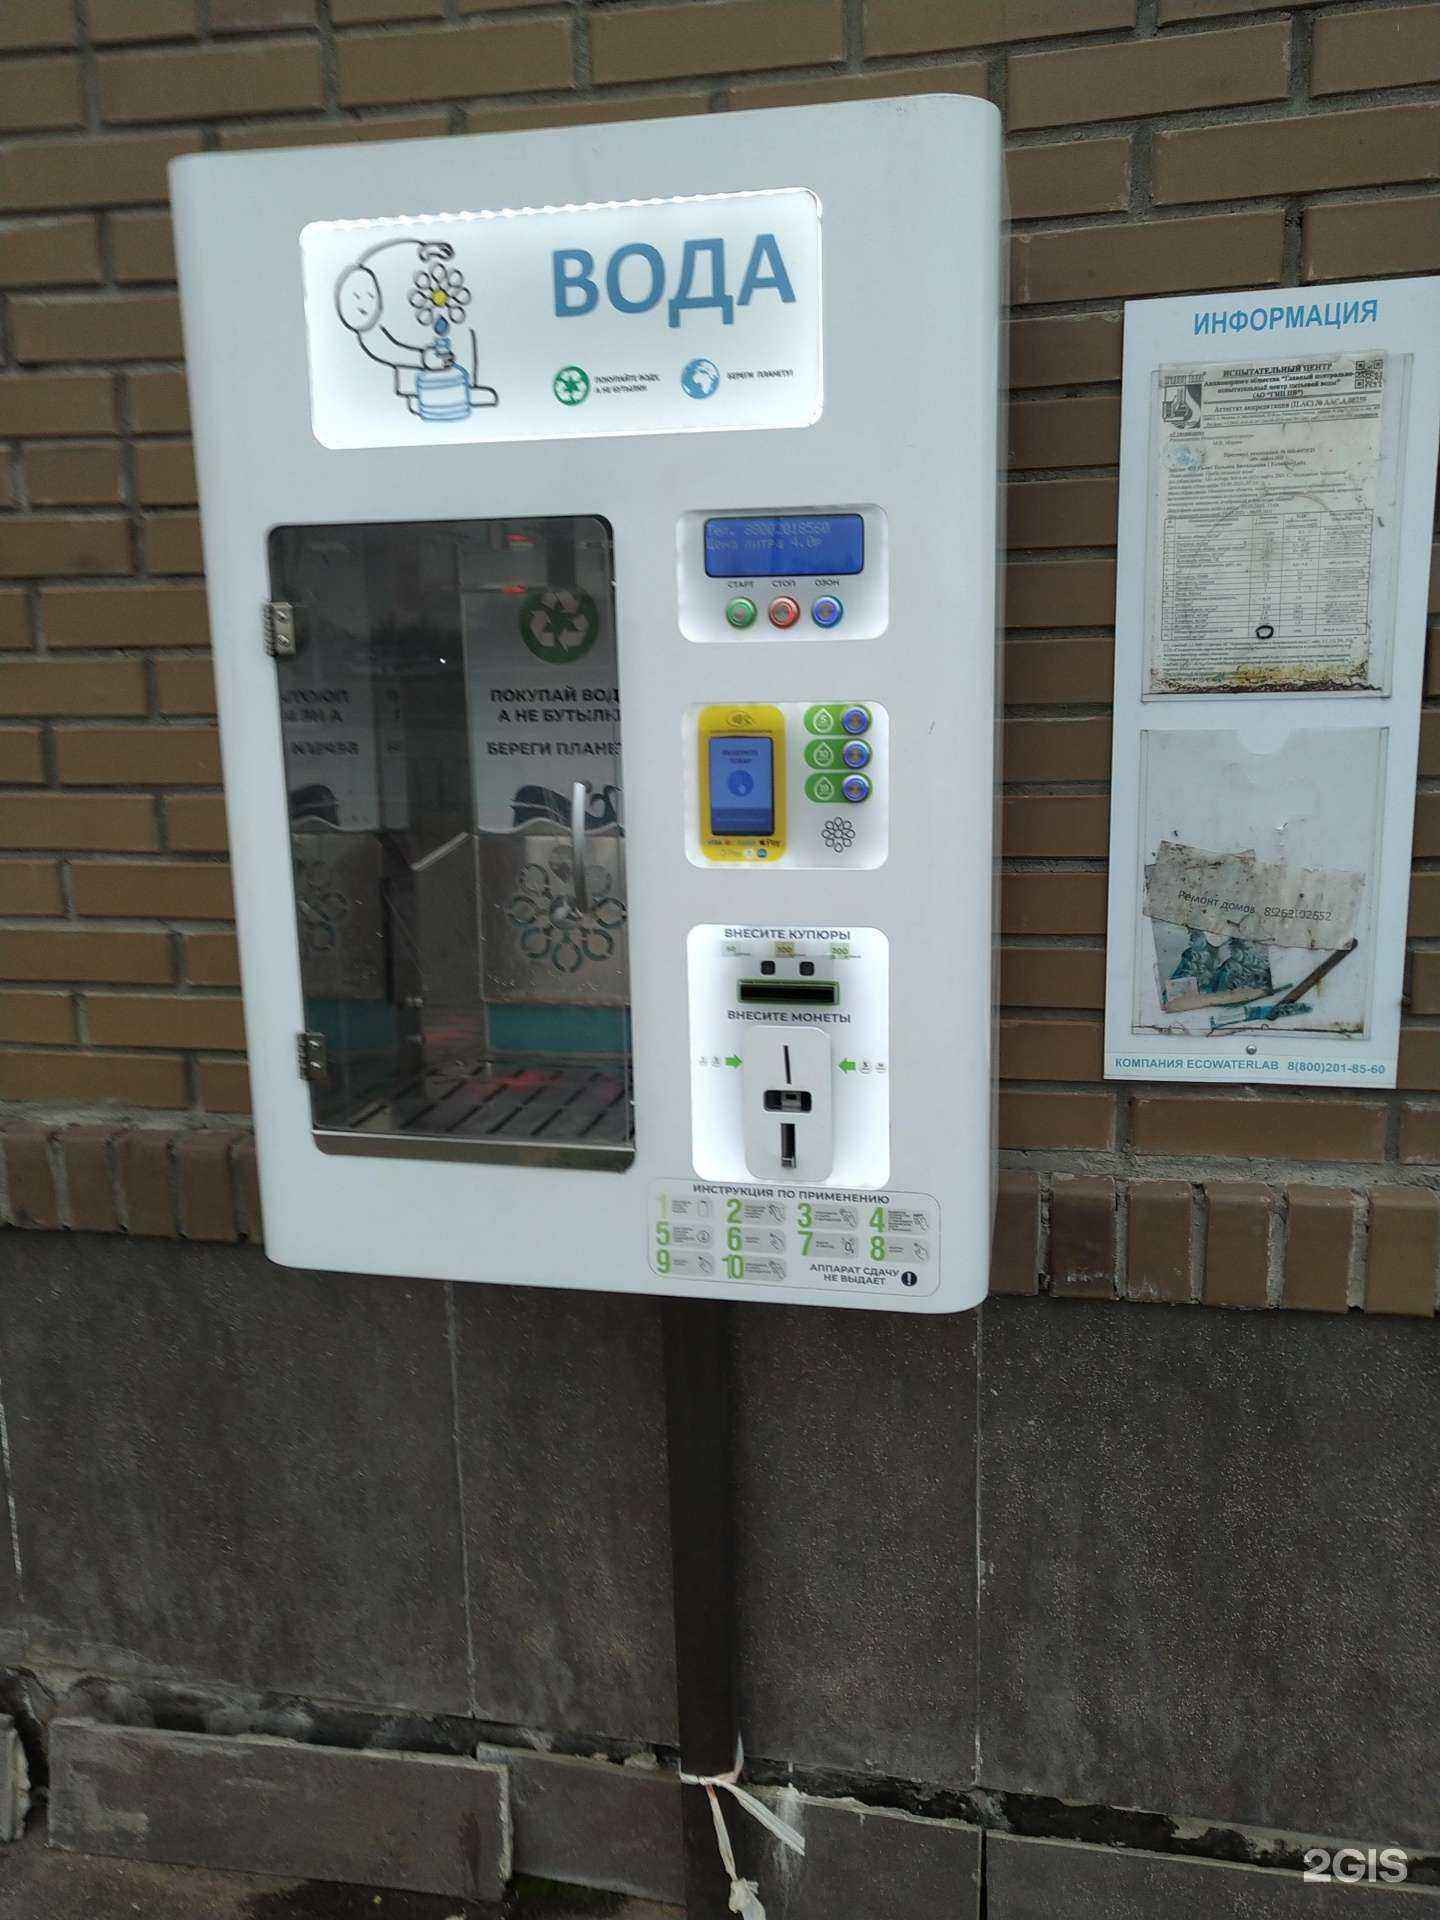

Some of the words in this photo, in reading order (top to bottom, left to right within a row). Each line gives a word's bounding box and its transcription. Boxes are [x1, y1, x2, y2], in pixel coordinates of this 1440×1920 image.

[552, 233, 797, 329] ВОДА
[1193, 299, 1379, 336] ИНФОРМАЦИЯ
[489, 685, 577, 703] ПОКУПАЙ
[581, 687, 620, 703] ВОД
[498, 709, 511, 723] А
[514, 709, 539, 723] НЕ
[543, 708, 621, 723] БУТЫЛК
[486, 741, 552, 756] БЕРЕГИ
[555, 741, 622, 756] ПЛАНЕ
[724, 928, 787, 939] ВНЕСИТЕ
[789, 930, 851, 941] КУПЮРЫ
[727, 1009, 788, 1022] ВНЕСИТЕ
[791, 1010, 851, 1024] МОНЕТЫ
[1115, 1057, 1184, 1069] КОМПАНИЯ
[1186, 1059, 1279, 1070] ECOWATERLAB
[1287, 1061, 1386, 1075] 8(800)201-85-60
[693, 1184, 774, 1198] ИНСТРУКЦИЯ
[777, 1188, 795, 1200] ПО
[798, 1190, 890, 1205] ПРИМЕНЕНИЮ
[726, 1198, 743, 1224] 2
[797, 1202, 812, 1228] 3
[869, 1206, 885, 1233] 4
[655, 1221, 670, 1246] 5
[727, 1226, 742, 1252] 6
[797, 1230, 813, 1256] 7
[656, 1248, 671, 1274] 9
[869, 1235, 886, 1262] 8
[721, 1254, 744, 1279] 10
[809, 1263, 861, 1274] АППАРАТ
[862, 1266, 900, 1277] СДАЧУ
[823, 1274, 839, 1282] НЕ
[840, 1274, 886, 1285] ВЫДАЕТ
